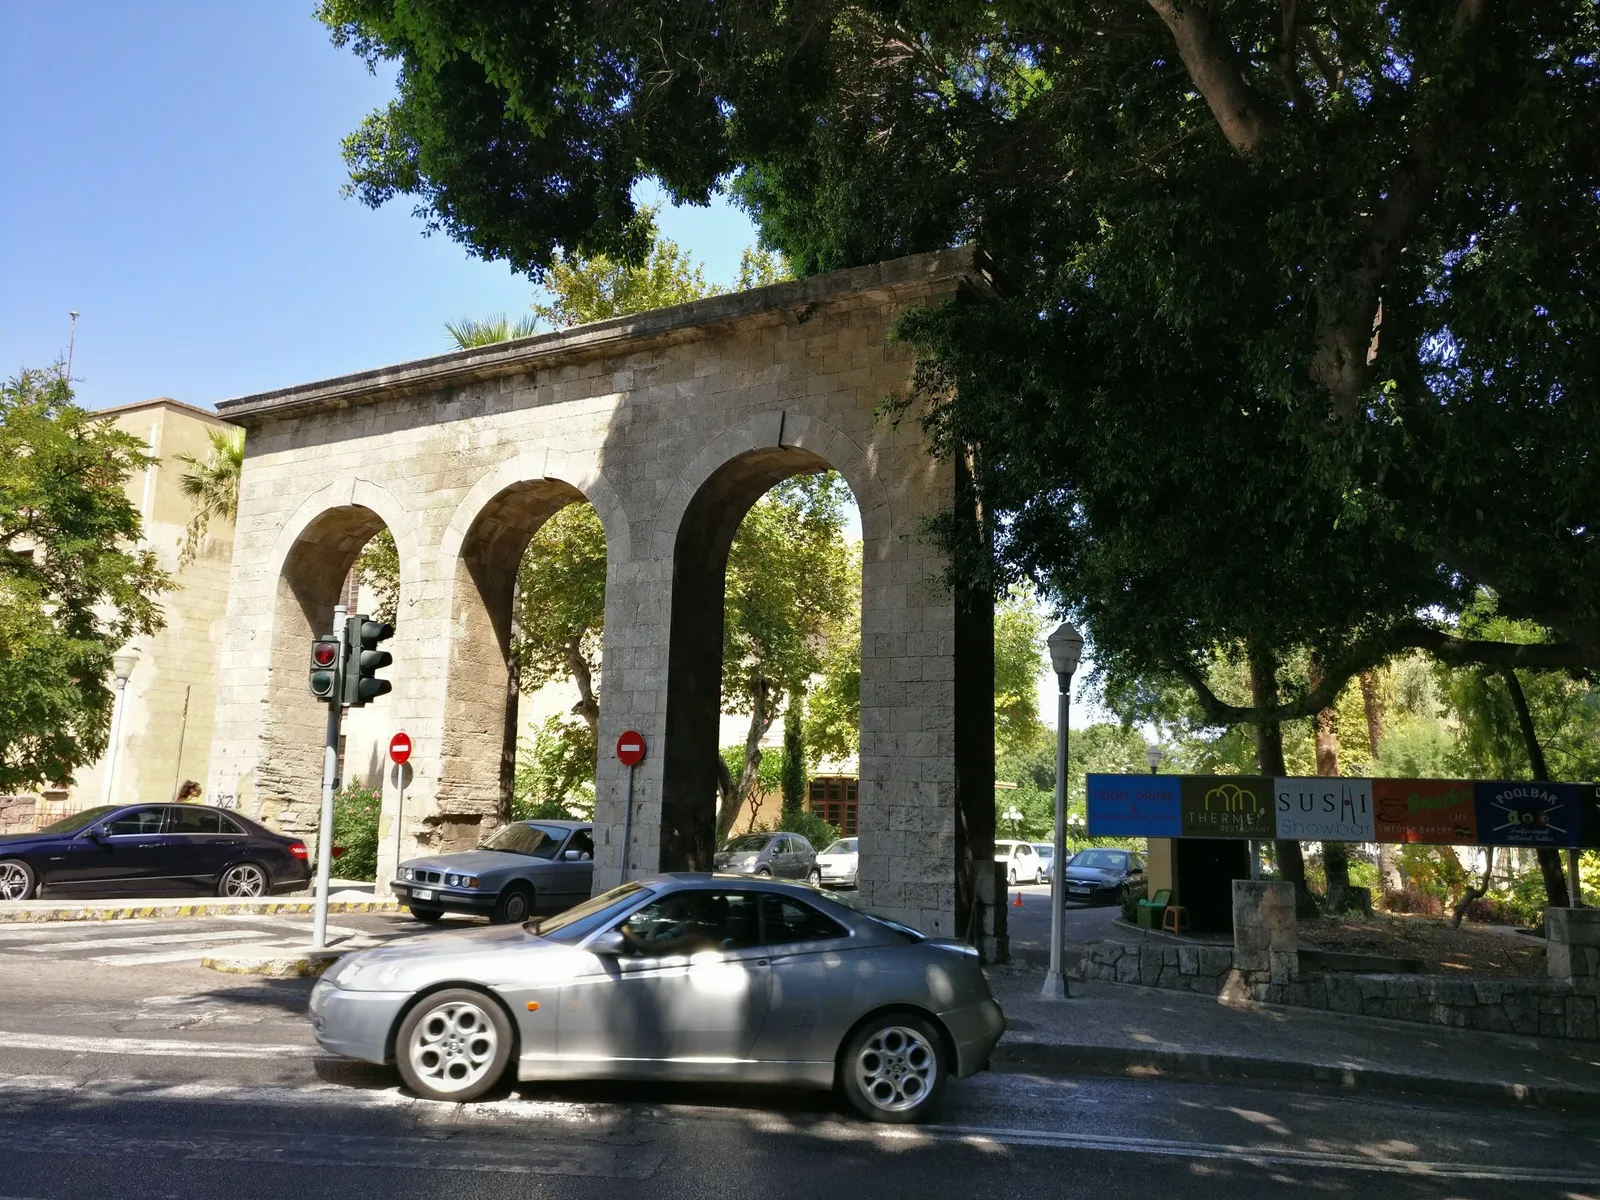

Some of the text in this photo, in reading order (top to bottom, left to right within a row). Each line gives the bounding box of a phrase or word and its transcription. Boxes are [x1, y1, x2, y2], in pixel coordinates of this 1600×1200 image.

[1094, 790, 1174, 801] FOOD DRINK
[1495, 787, 1558, 805] POOLBAR
[1188, 812, 1255, 825] THERME
[1220, 824, 1270, 833] RESTAURANT
[1378, 825, 1452, 835] SWEDISH BAKERY
